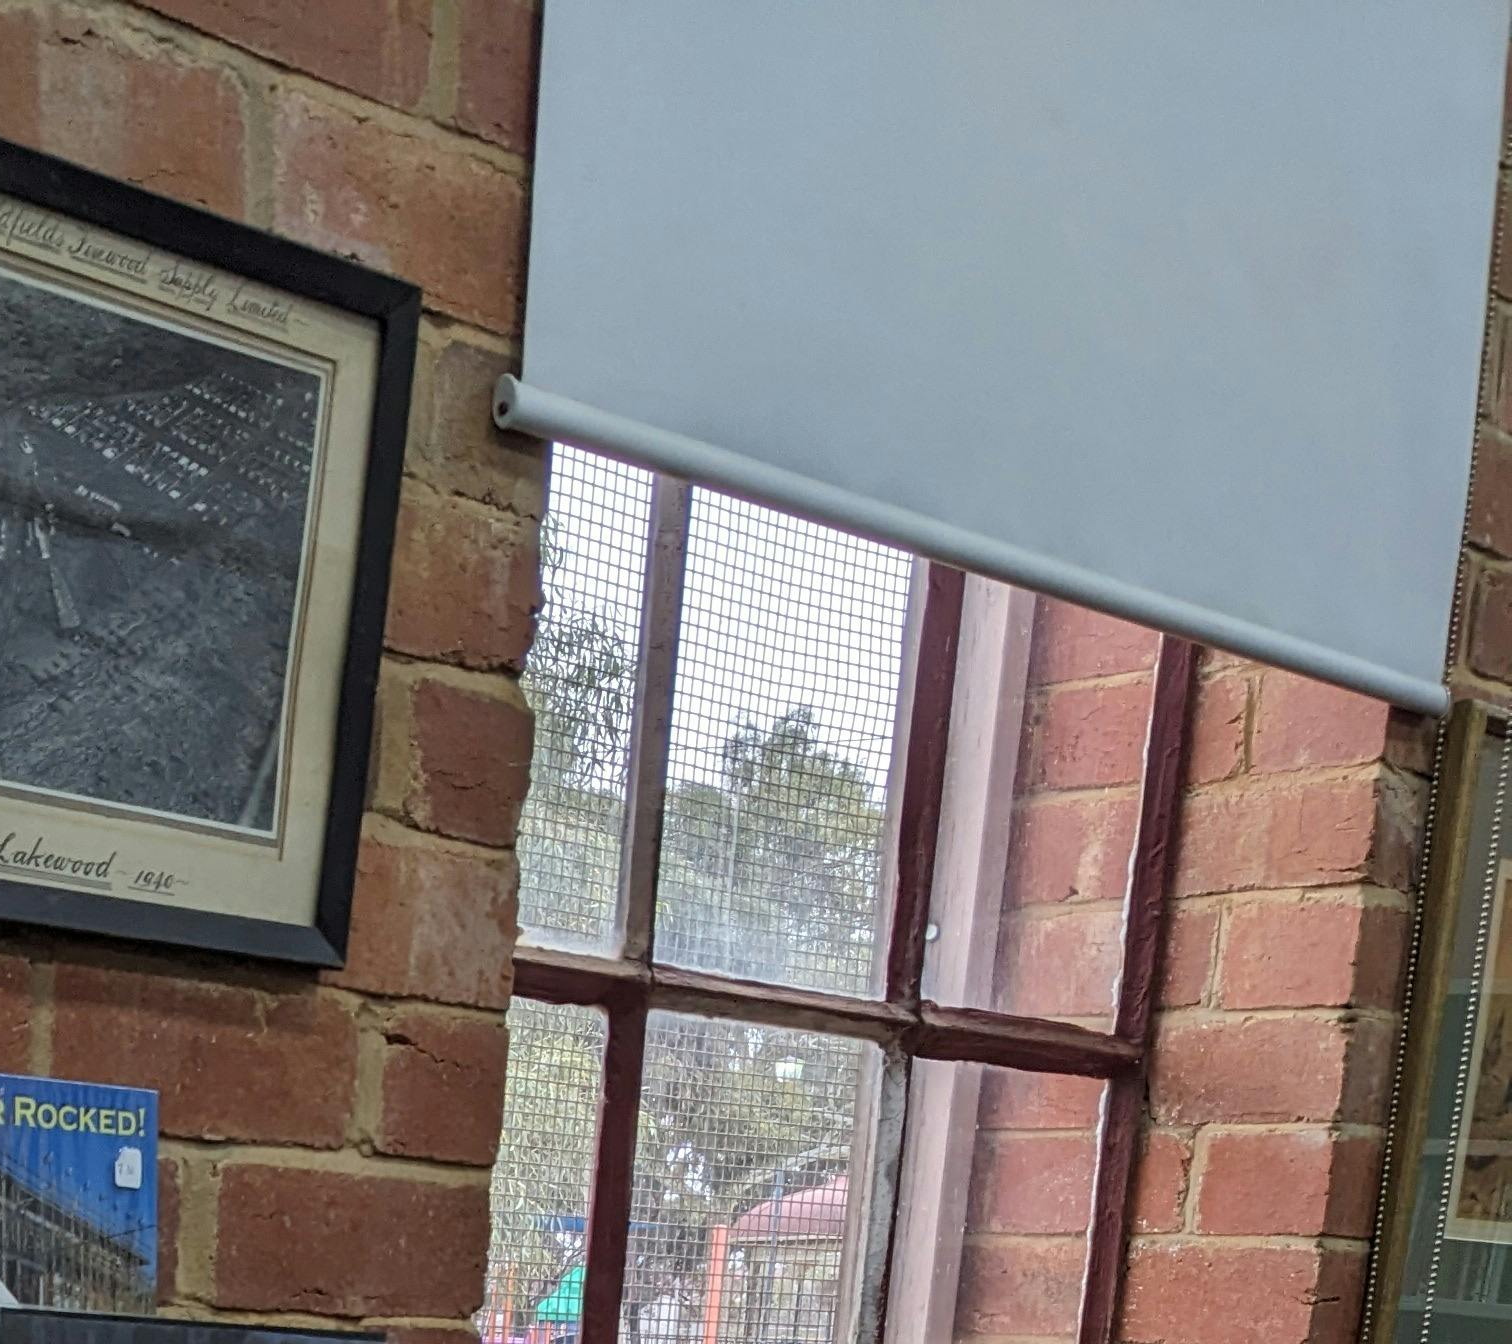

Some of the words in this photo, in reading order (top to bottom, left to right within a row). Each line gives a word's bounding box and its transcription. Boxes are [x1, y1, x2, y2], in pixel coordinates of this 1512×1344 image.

[159, 258, 219, 312] Supply
[227, 285, 289, 325] Limited
[14, 1096, 147, 1138] ROCKED!
